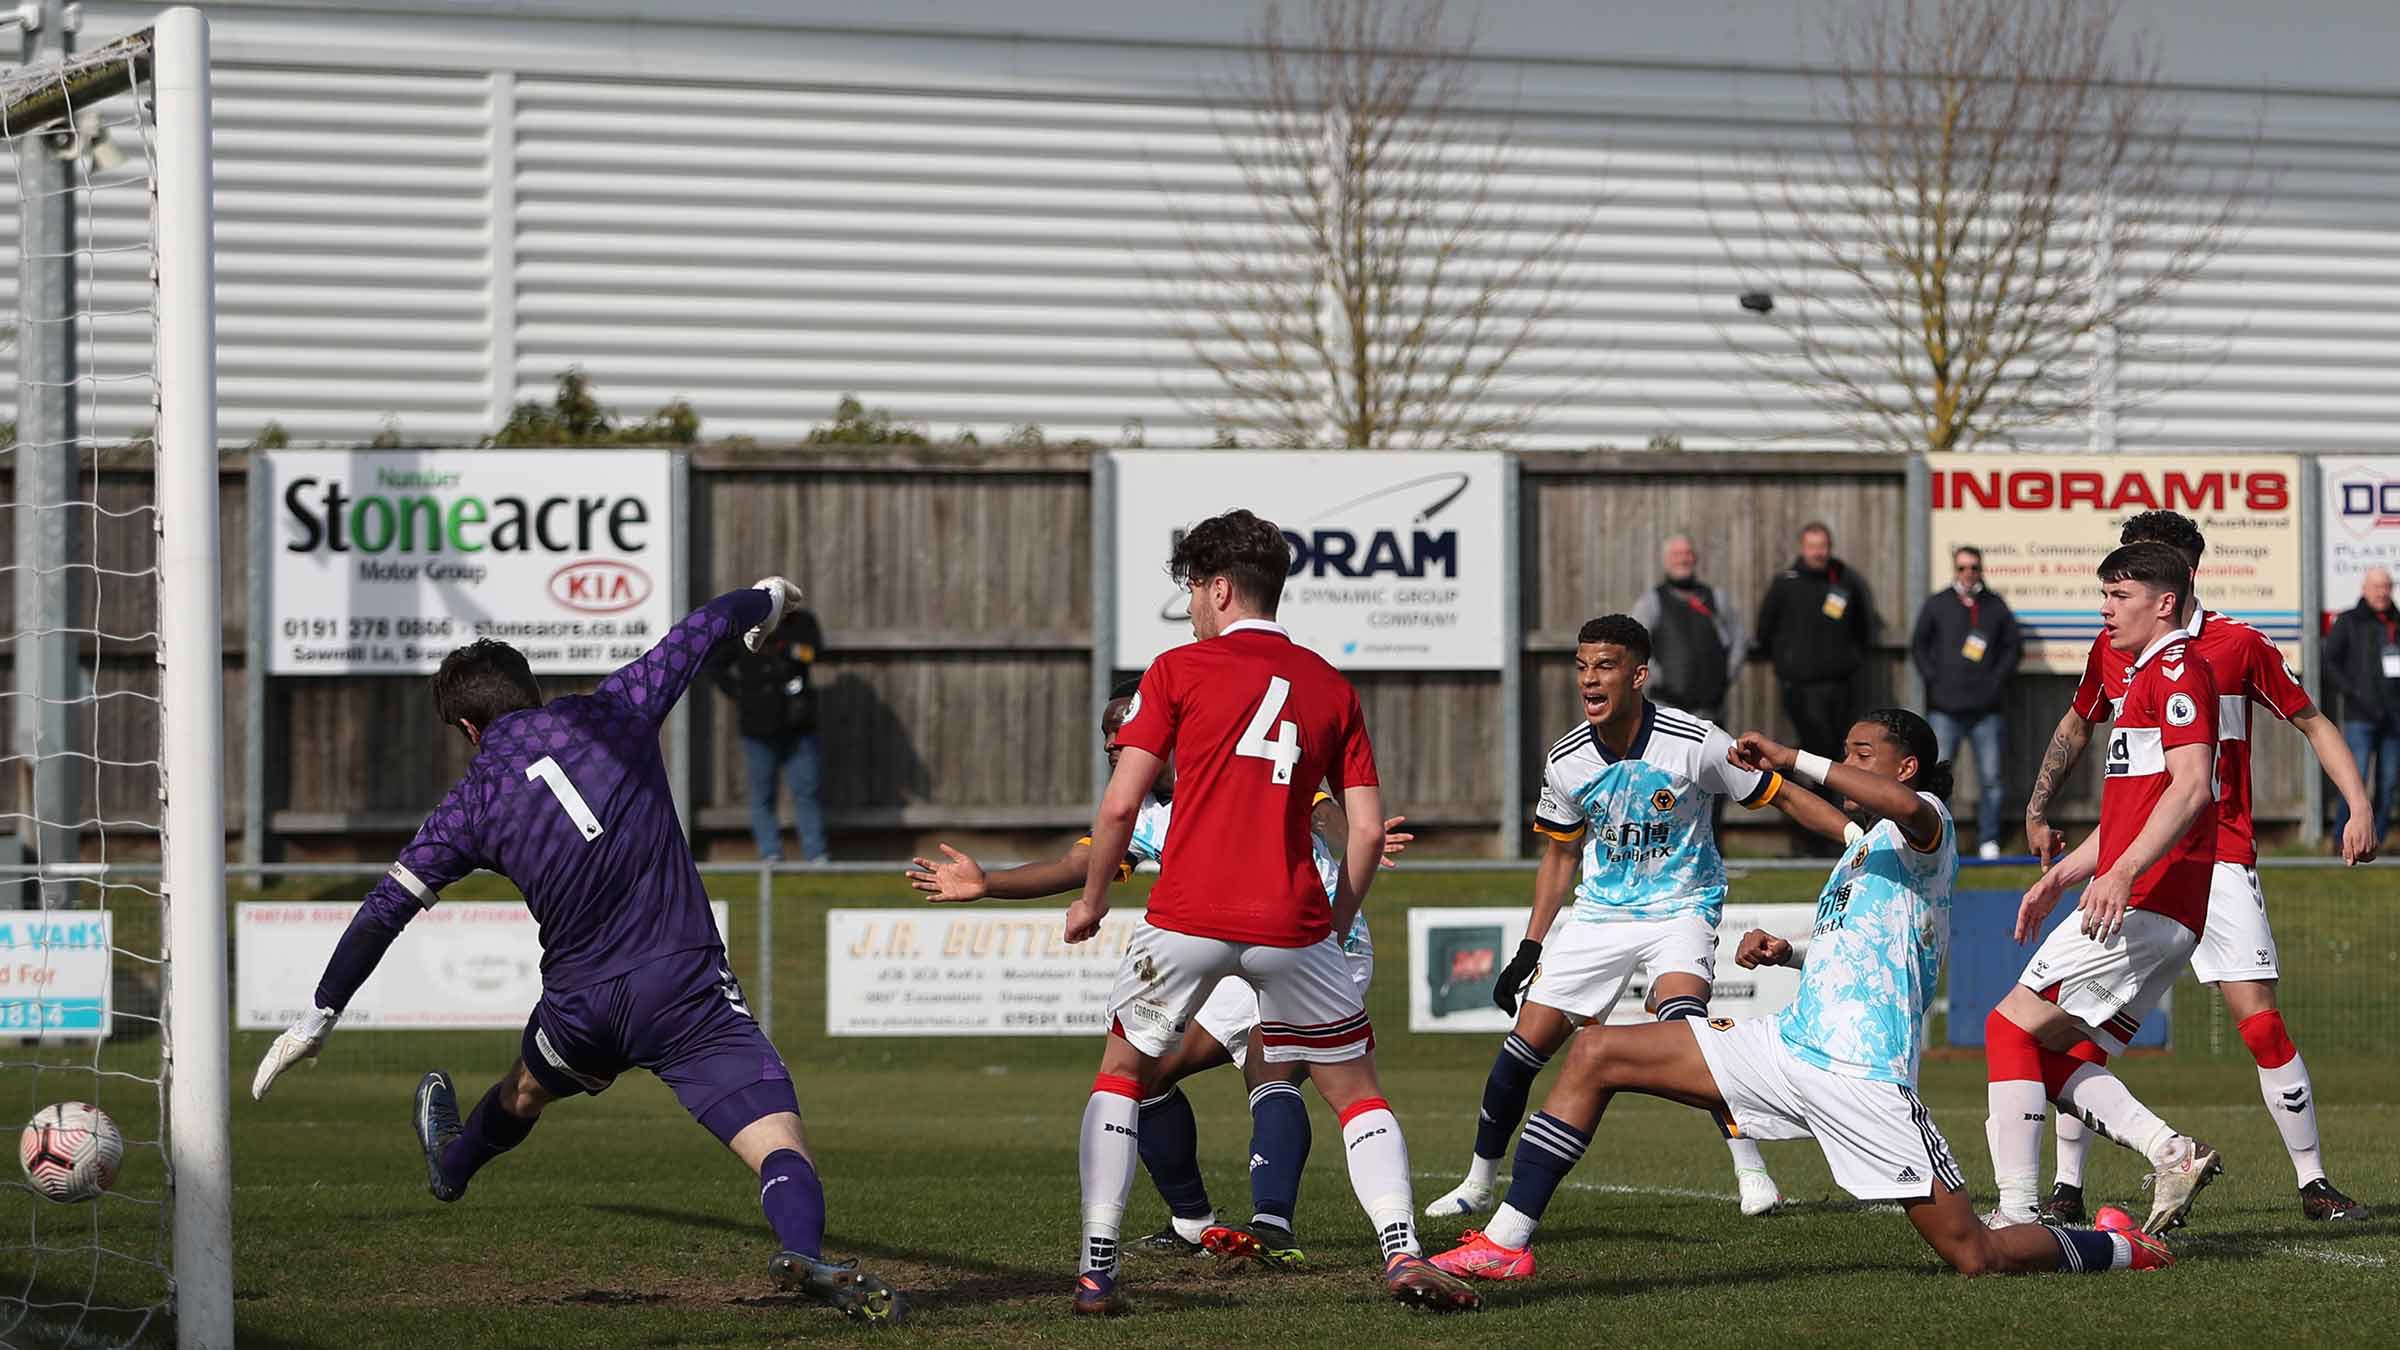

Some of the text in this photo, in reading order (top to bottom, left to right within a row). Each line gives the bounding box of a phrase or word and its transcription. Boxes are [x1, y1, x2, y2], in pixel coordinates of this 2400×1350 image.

[1931, 471, 2290, 511] INGRAM'S
[285, 476, 648, 554] Stoneacre
[2205, 517, 2290, 529] Auckland
[2214, 545, 2270, 559] Storage
[359, 559, 487, 584] Motor Group
[567, 575, 634, 602] KIA
[1301, 589, 1385, 604] DYNAMIC
[1393, 589, 1459, 604] GROUP
[284, 619, 339, 639] 0191
[1368, 613, 1458, 629] COMPANY
[1235, 675, 1303, 785] 4
[525, 755, 604, 843] 1
[1620, 821, 1672, 848] 万博
[26, 920, 105, 951] VANS
[850, 919, 922, 957] J.R.
[19, 964, 56, 985] For
